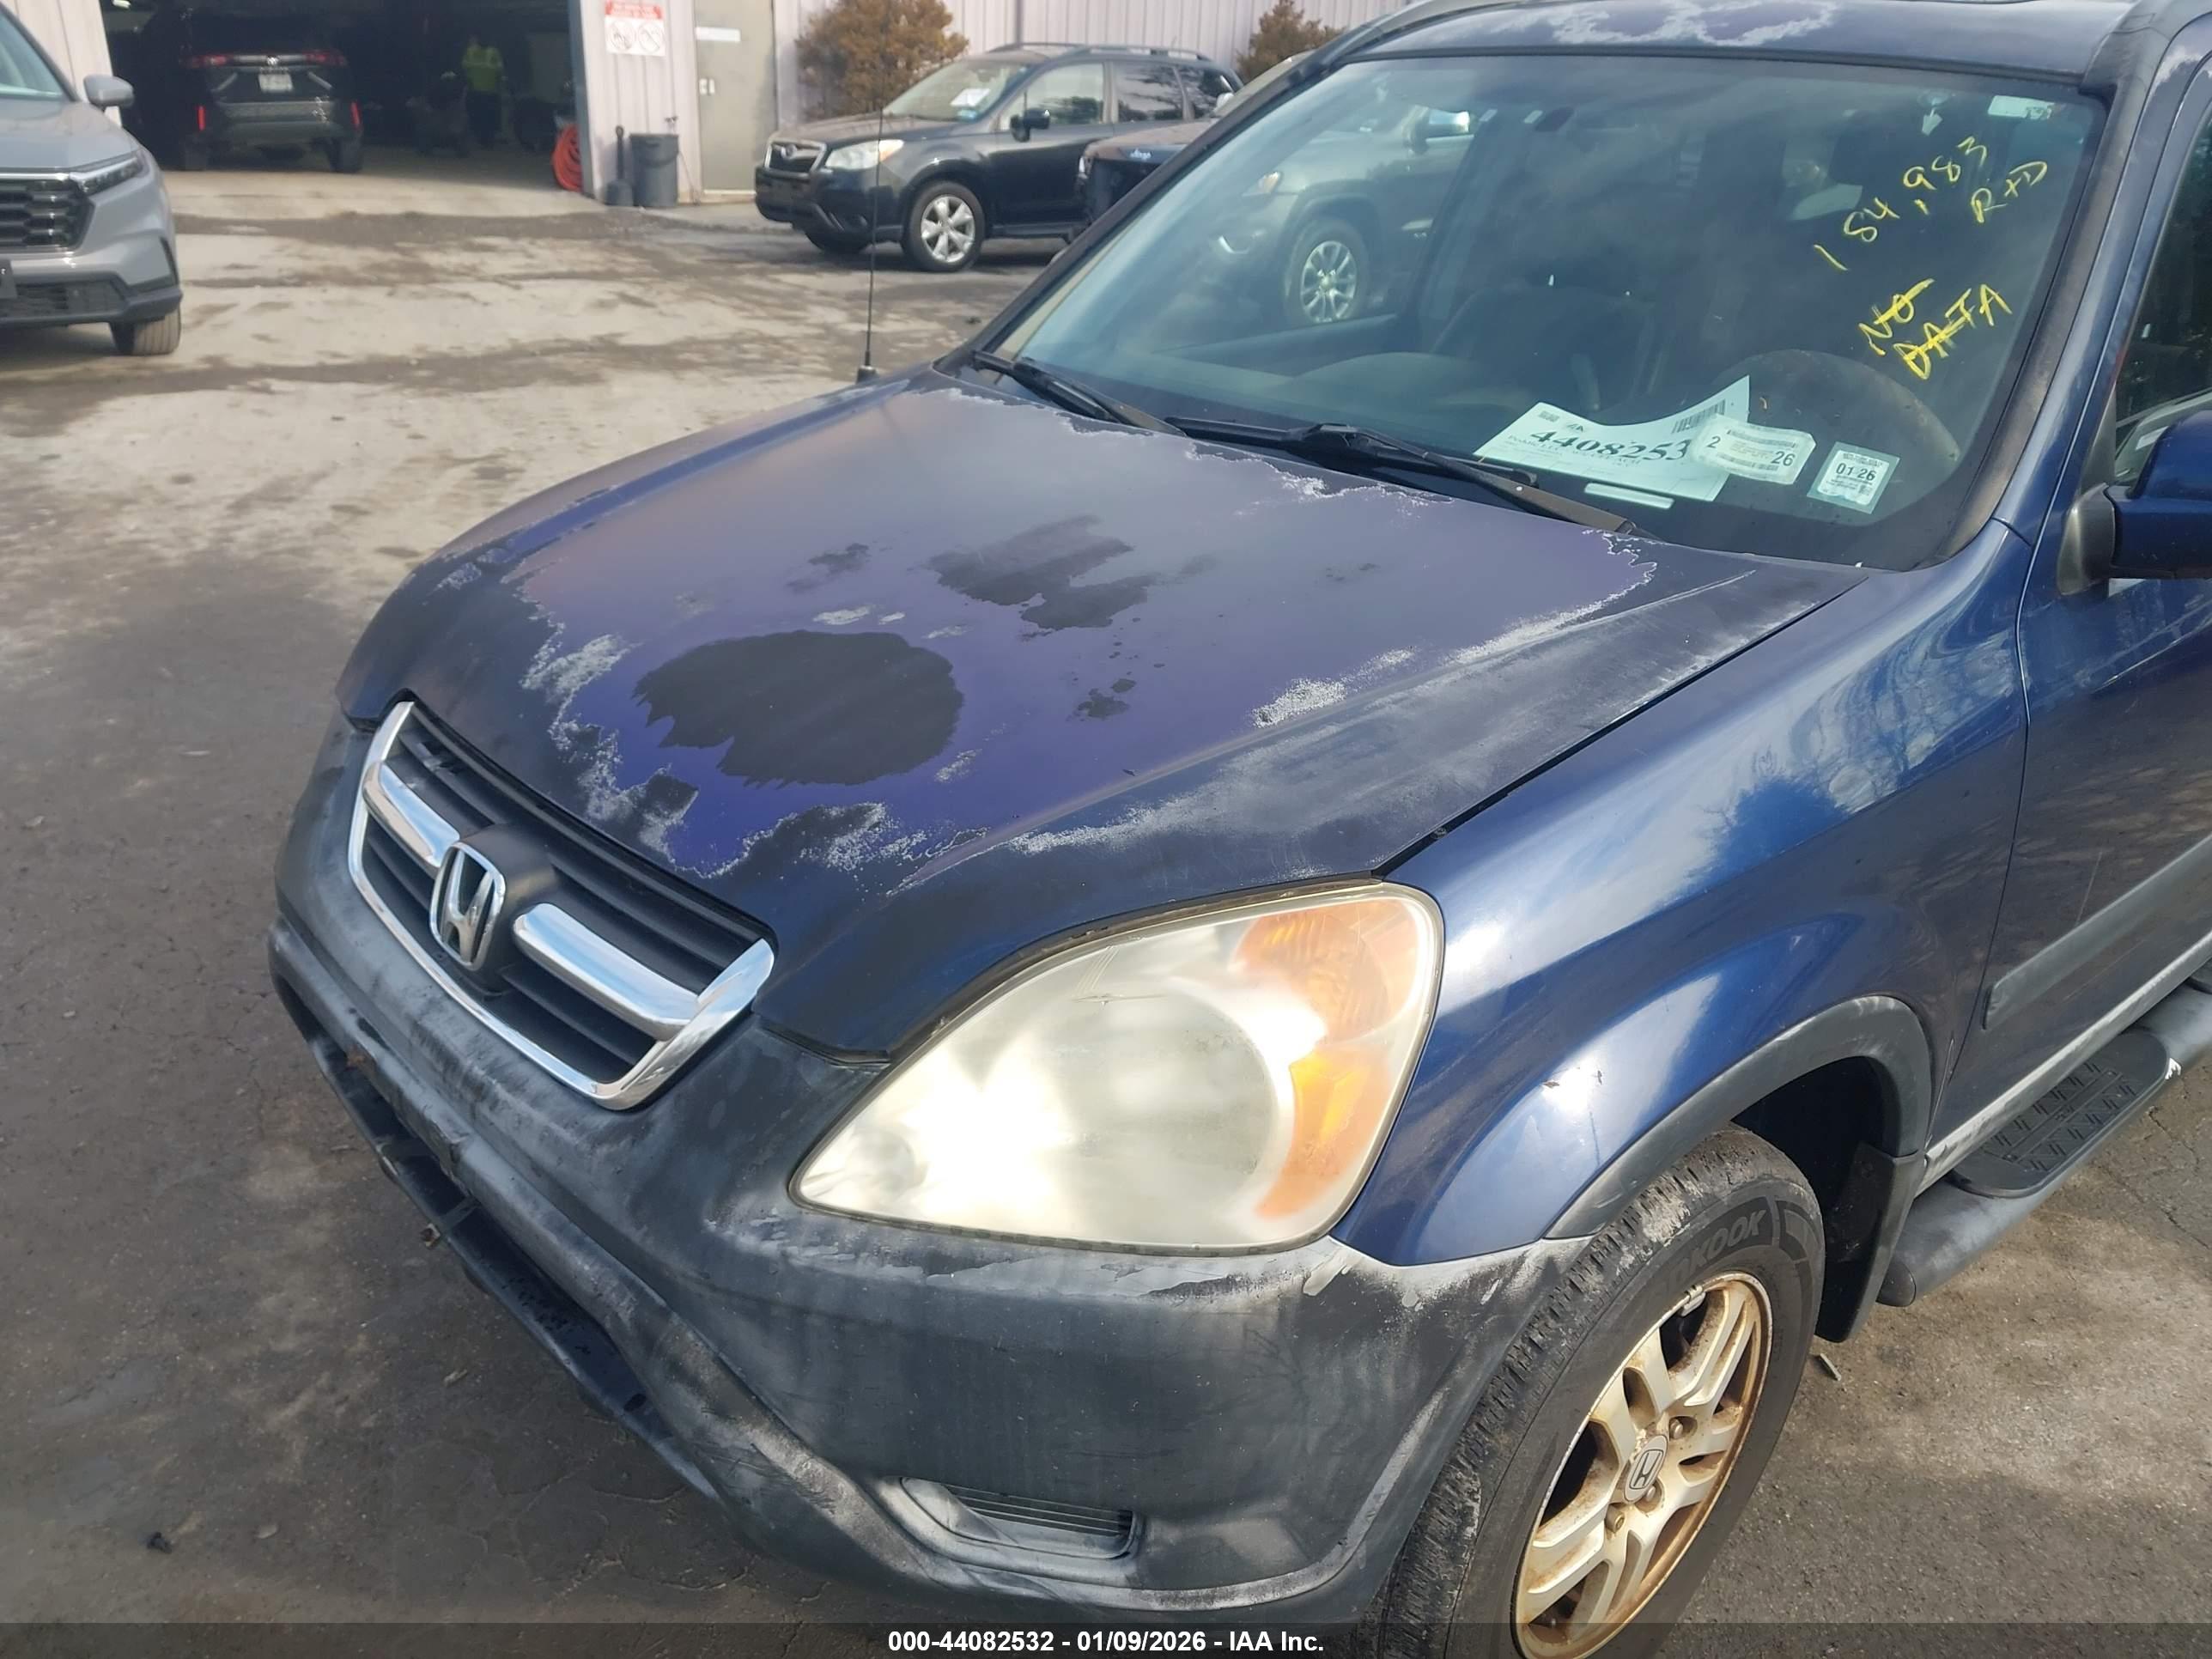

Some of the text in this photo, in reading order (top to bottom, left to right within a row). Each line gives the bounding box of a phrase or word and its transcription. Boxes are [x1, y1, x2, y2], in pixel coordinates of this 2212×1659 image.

[1893, 283, 2013, 380] DATA
[1706, 435, 1721, 448] 2
[1771, 451, 1796, 466] 26
[1836, 463, 1877, 481] 01 26
